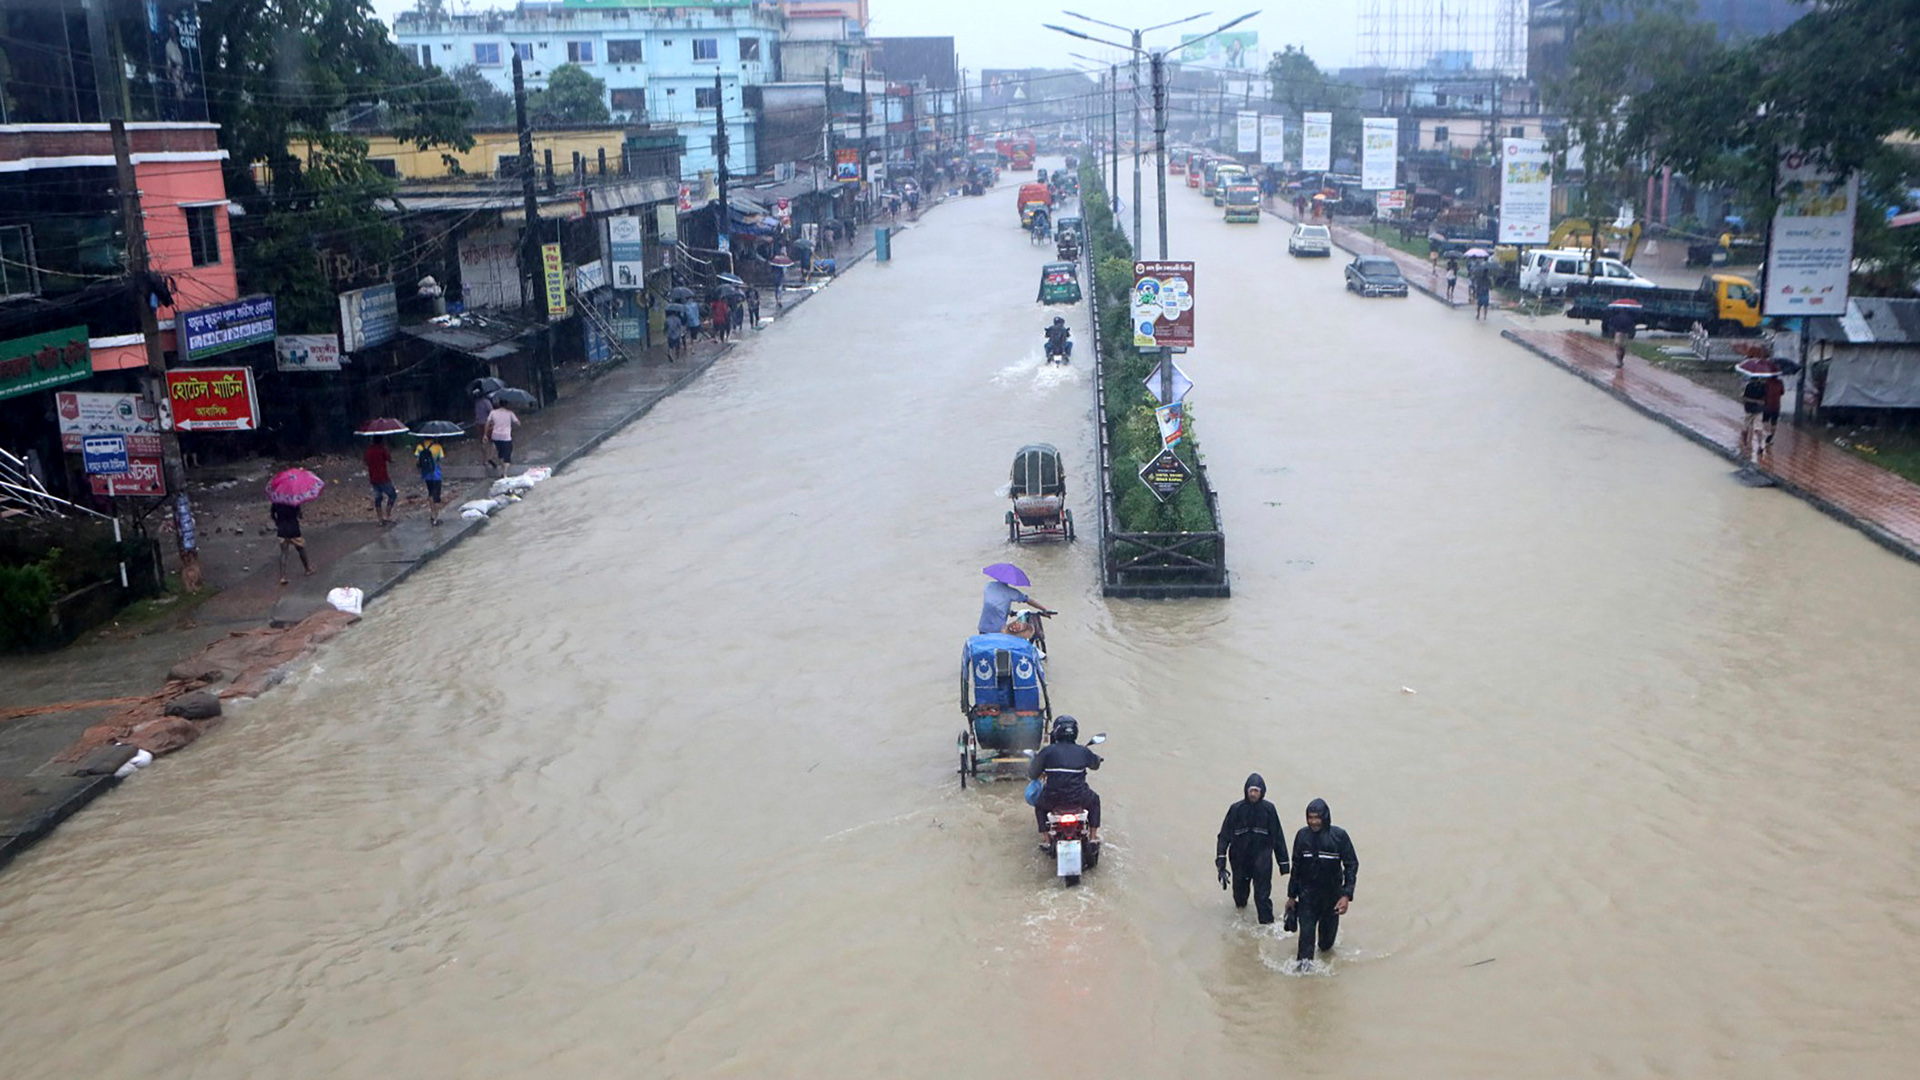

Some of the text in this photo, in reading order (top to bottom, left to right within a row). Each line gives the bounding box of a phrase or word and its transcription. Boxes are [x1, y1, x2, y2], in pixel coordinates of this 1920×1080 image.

[172, 373, 244, 402] হোটেল মার্টিন
[195, 403, 228, 417] আবাসিক
